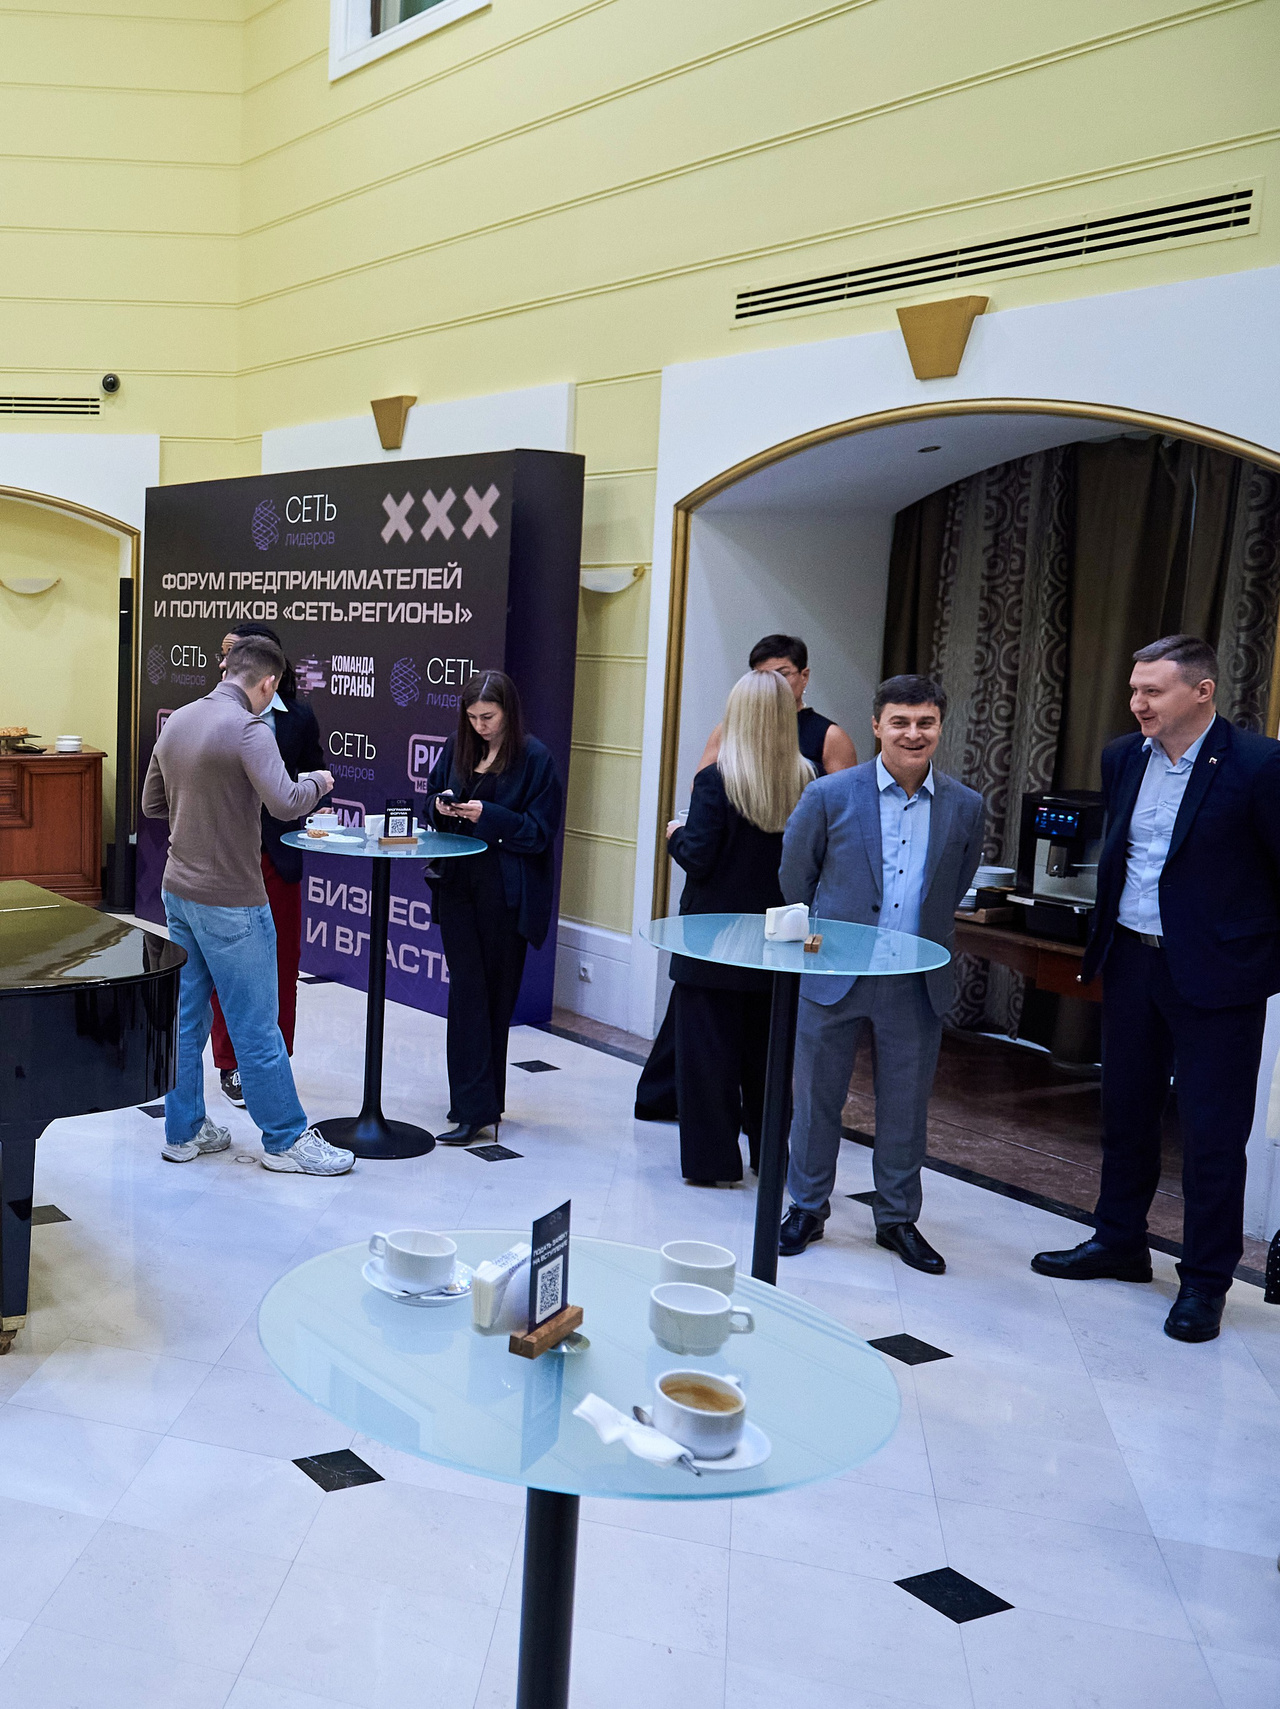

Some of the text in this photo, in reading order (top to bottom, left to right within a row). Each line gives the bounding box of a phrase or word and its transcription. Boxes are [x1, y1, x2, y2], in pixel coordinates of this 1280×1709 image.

[285, 494, 337, 524] СЕТЬ
[285, 531, 335, 550] лидеров
[162, 562, 463, 594] ФОРУМ ПРЕДПРИНИМАТЕЛЕЙ
[154, 600, 473, 625] И ПОЛИТИКОВ «СЕТЬ.РЕГИОНЫ»
[170, 644, 207, 668] СЕТЬ
[331, 655, 375, 676] КОМАНДА
[170, 672, 206, 687] лидеров
[330, 674, 375, 698] СТРАНЫ
[328, 730, 376, 760] СЕТЬ
[329, 763, 375, 783] лидеров
[308, 876, 431, 931] БИЗЕС
[306, 917, 328, 948] И
